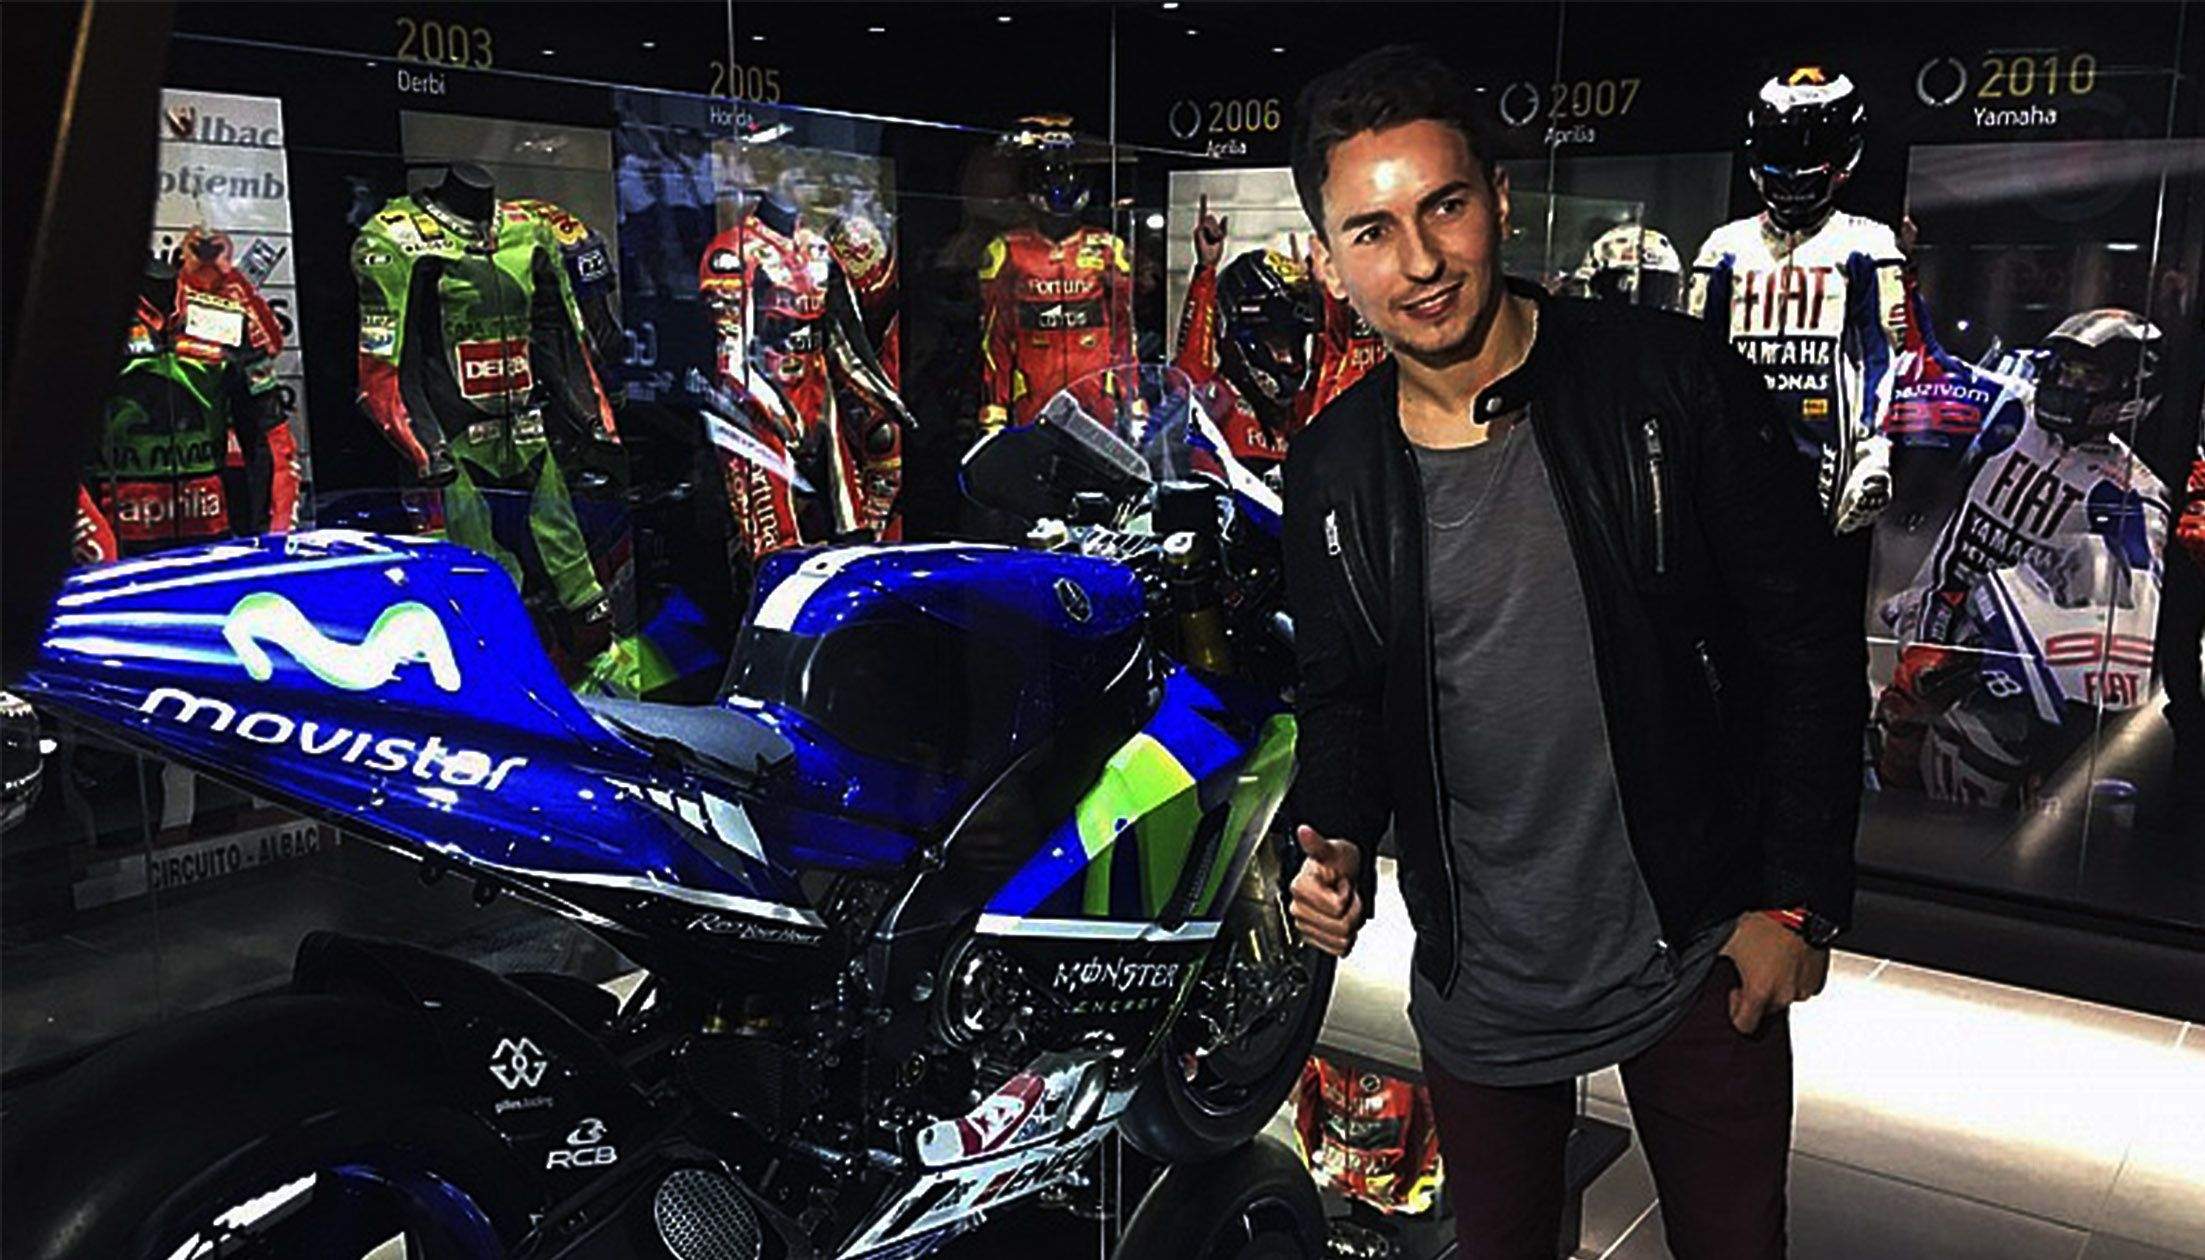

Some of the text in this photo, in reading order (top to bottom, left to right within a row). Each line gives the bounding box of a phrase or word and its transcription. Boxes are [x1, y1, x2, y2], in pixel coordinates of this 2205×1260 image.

[396, 16, 494, 69] 2003
[397, 69, 446, 95] Derbi
[709, 61, 781, 104] 2005
[1976, 53, 2096, 98] 2010
[1208, 99, 1281, 132] 2006
[1548, 78, 1642, 118] 2007
[1973, 104, 2058, 127] Yamaha
[1737, 340, 1830, 364] YAMAHA
[118, 487, 220, 529] aprilia
[1986, 450, 2085, 538] FIAT
[2084, 670, 2140, 706] FIAT
[138, 687, 529, 792] movistar
[151, 843, 241, 889] CIRCUITO
[545, 1145, 618, 1170] RCB
